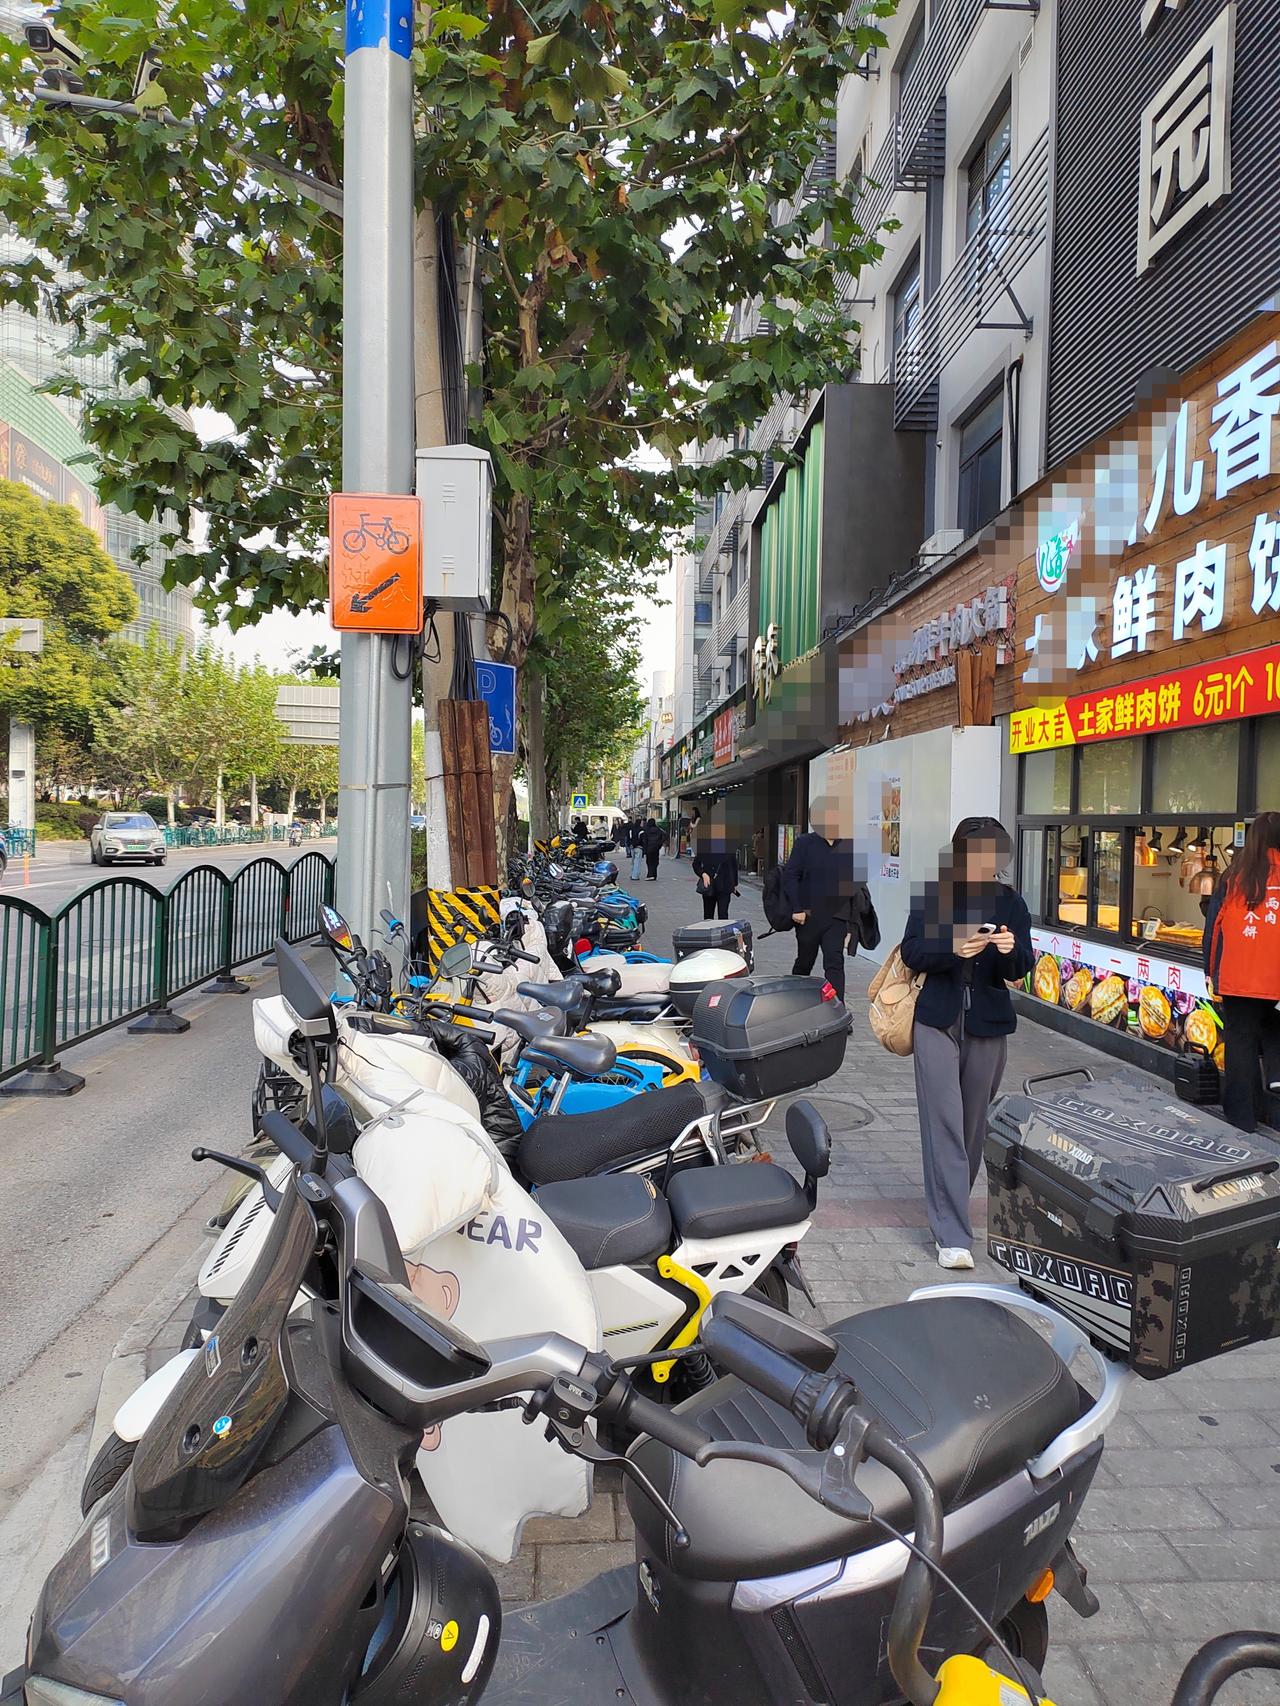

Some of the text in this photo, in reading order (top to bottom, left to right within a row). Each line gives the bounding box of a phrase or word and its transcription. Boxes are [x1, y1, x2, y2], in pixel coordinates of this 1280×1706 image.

[1136, 0, 1237, 278] 园
[1096, 340, 1280, 548] 儿香
[476, 667, 496, 701] P
[1011, 708, 1067, 749] 开业大吉
[1077, 680, 1182, 738] 土家鲜肉饼
[1192, 665, 1255, 719] 6元1个
[1242, 900, 1261, 940] 个饼
[1110, 957, 1181, 989] 一两肉
[456, 1208, 542, 1254] EAR
